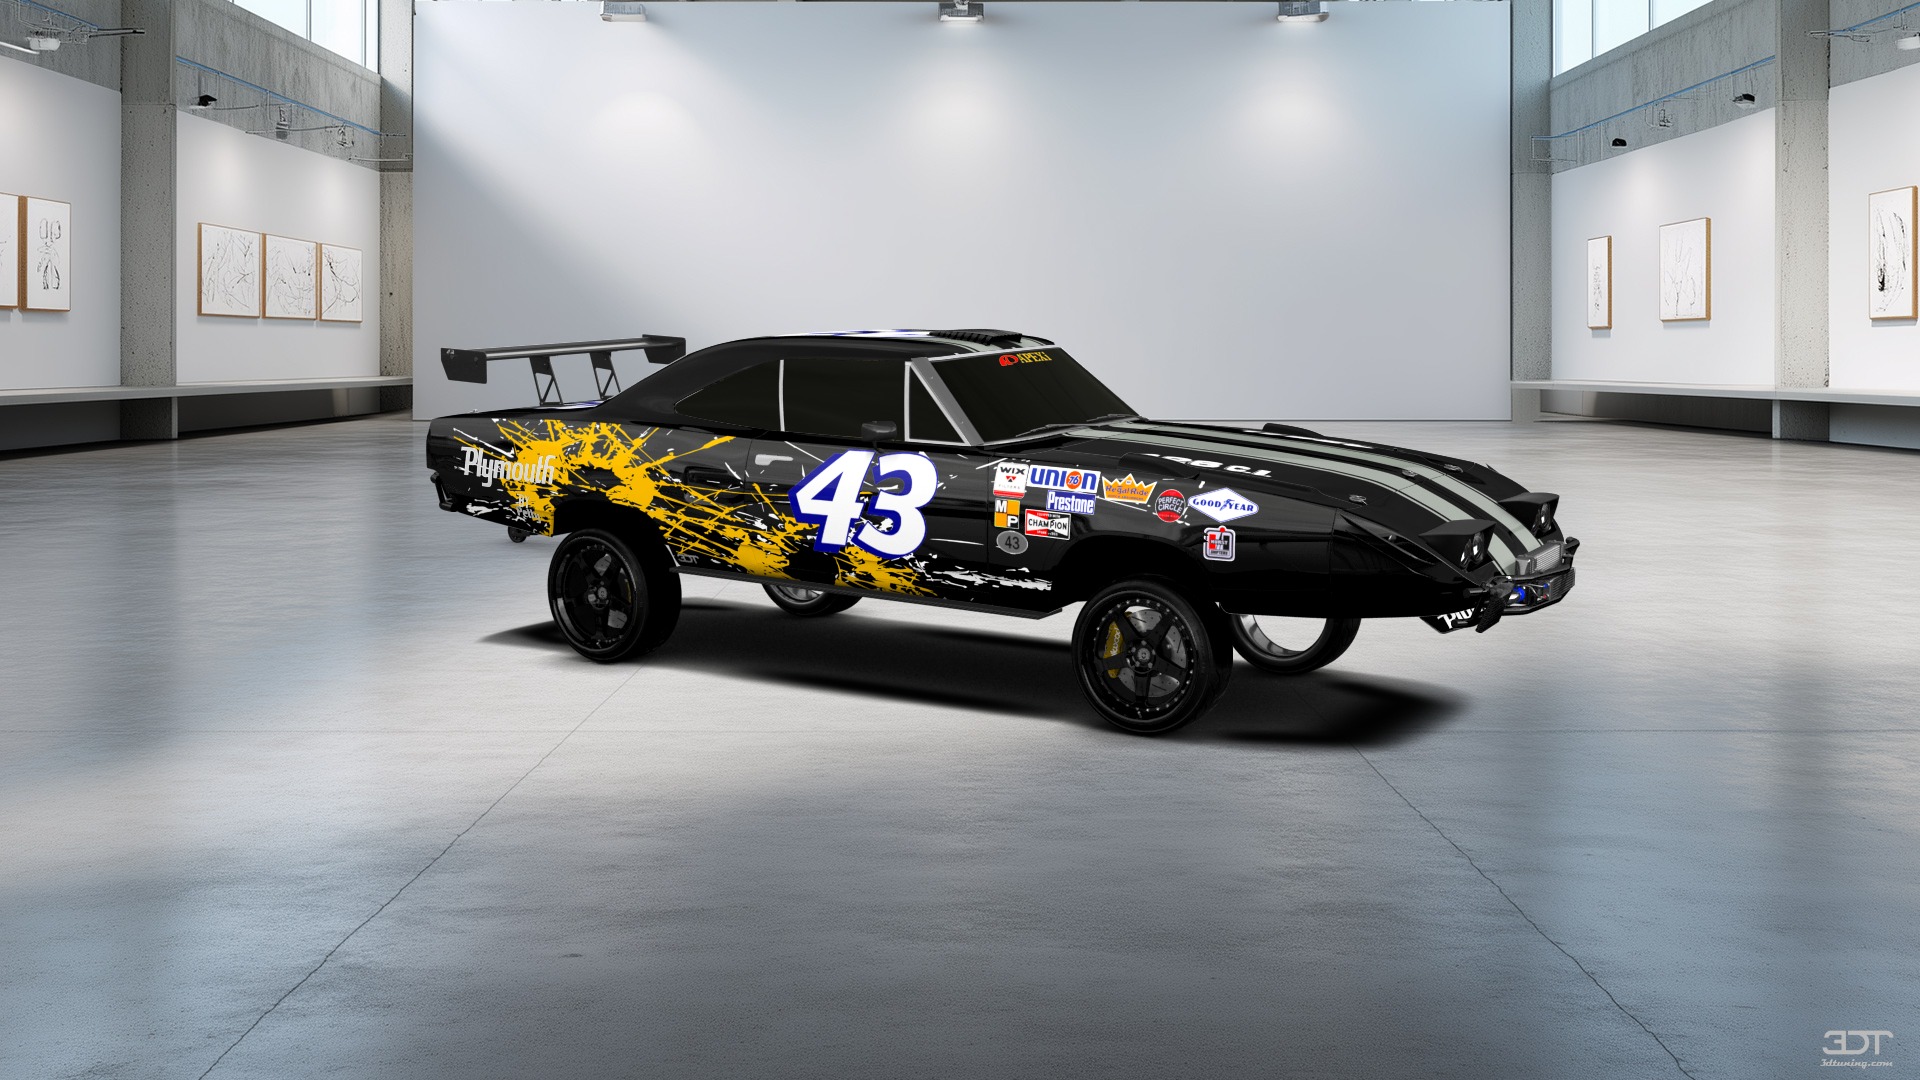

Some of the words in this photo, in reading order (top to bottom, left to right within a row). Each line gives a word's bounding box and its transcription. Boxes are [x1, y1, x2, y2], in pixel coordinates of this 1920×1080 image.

[461, 446, 556, 487] Plymouth
[1000, 466, 1026, 475] WIX
[1068, 475, 1080, 485] 76
[788, 449, 939, 560] 43
[995, 499, 1008, 513] M
[1047, 491, 1095, 513] Prestone
[1158, 496, 1184, 507] PERFECT
[1158, 503, 1183, 514] CIRCLE
[1007, 515, 1019, 527] P
[1028, 518, 1068, 530] CHAMPION
[1004, 535, 1021, 550] 43
